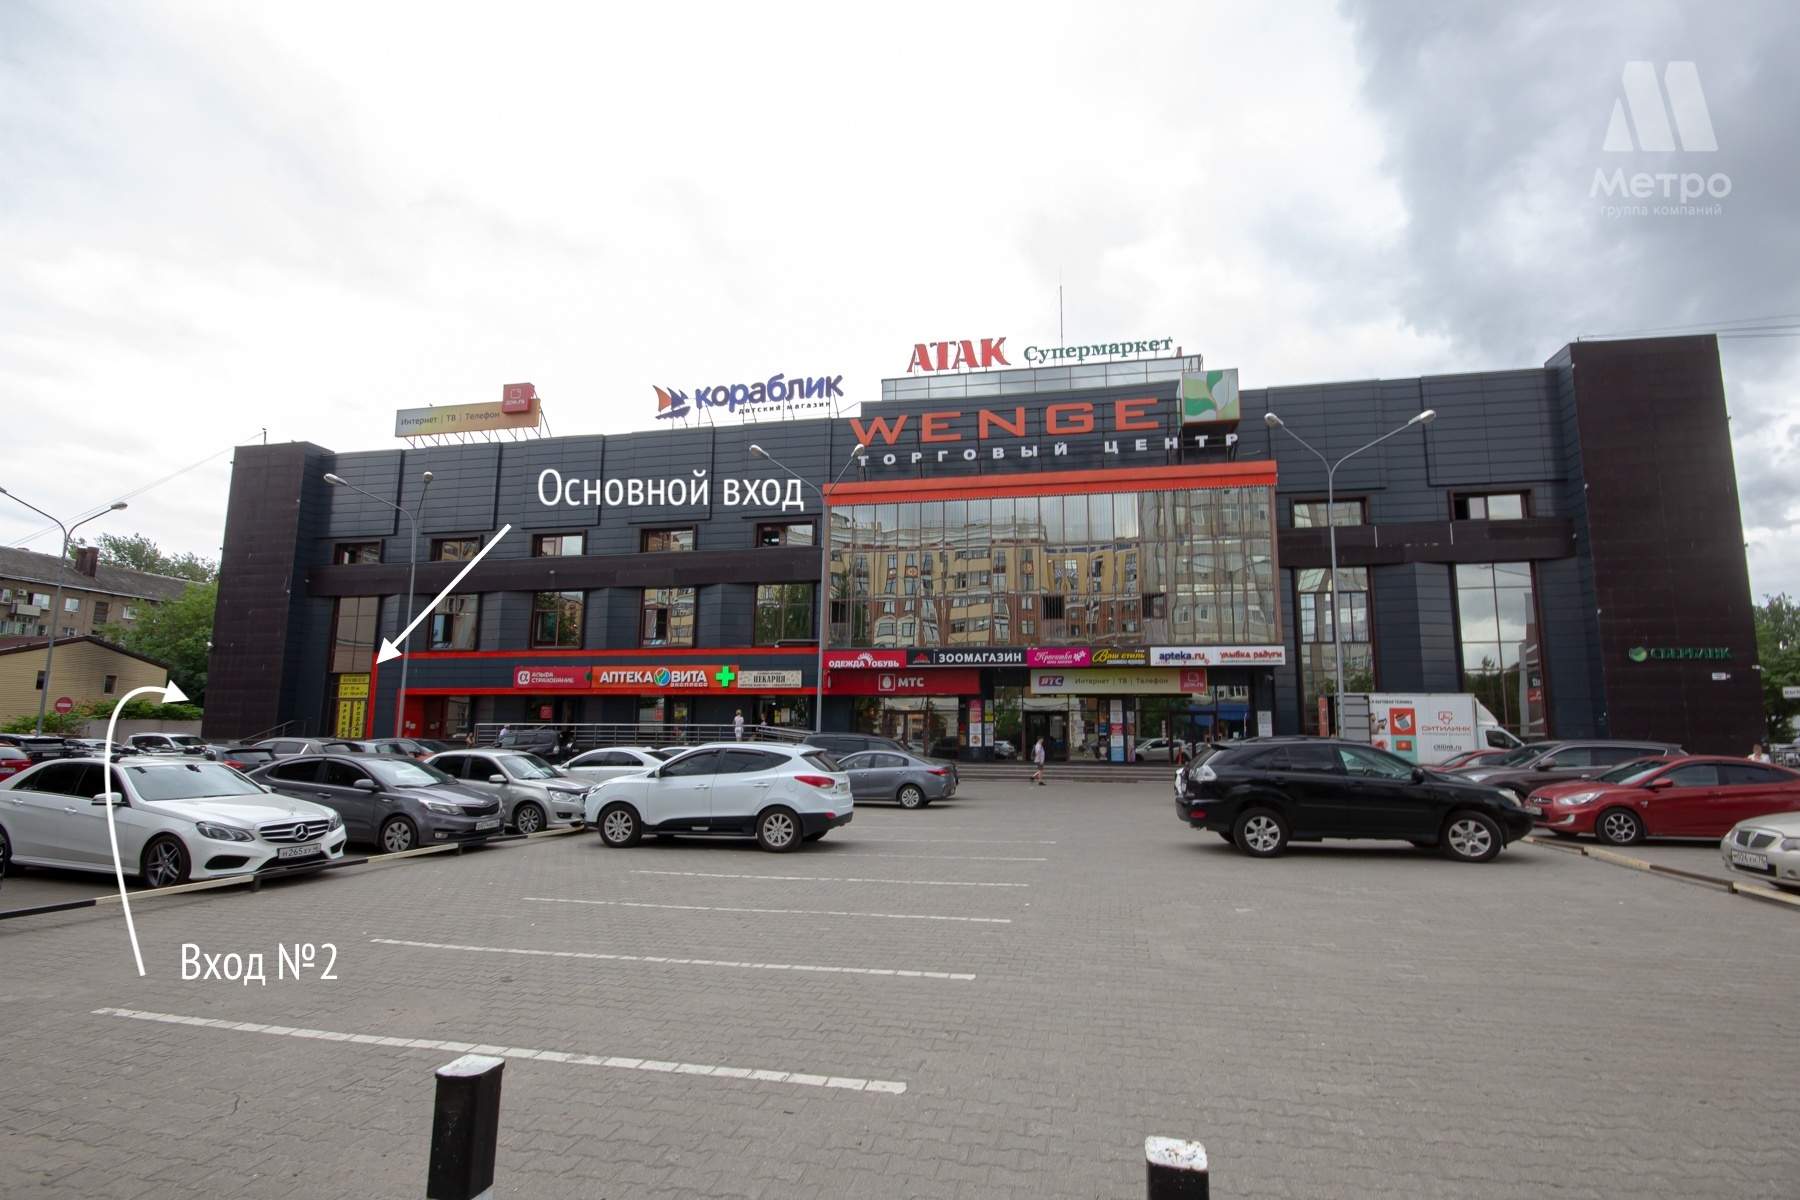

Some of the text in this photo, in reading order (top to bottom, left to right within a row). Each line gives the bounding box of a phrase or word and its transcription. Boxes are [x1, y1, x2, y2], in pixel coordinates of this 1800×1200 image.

[907, 336, 1173, 372] АТАК Супермаркет
[695, 373, 844, 412] кораблик
[738, 401, 831, 415] детский магазин
[401, 412, 500, 426] Интернет ТВ Телефон
[849, 397, 1159, 446] WENGE
[857, 433, 1239, 467] ТОРГОВЫЙ ЦЕНТР
[939, 653, 1022, 663] ЗООМАГАЗИН
[1159, 651, 1205, 662] apteka.ru
[828, 660, 900, 669] ОДЕЖДА ОБУВЬ
[600, 670, 707, 684] АПТЕКА ВИТА
[898, 677, 925, 687] МТС
